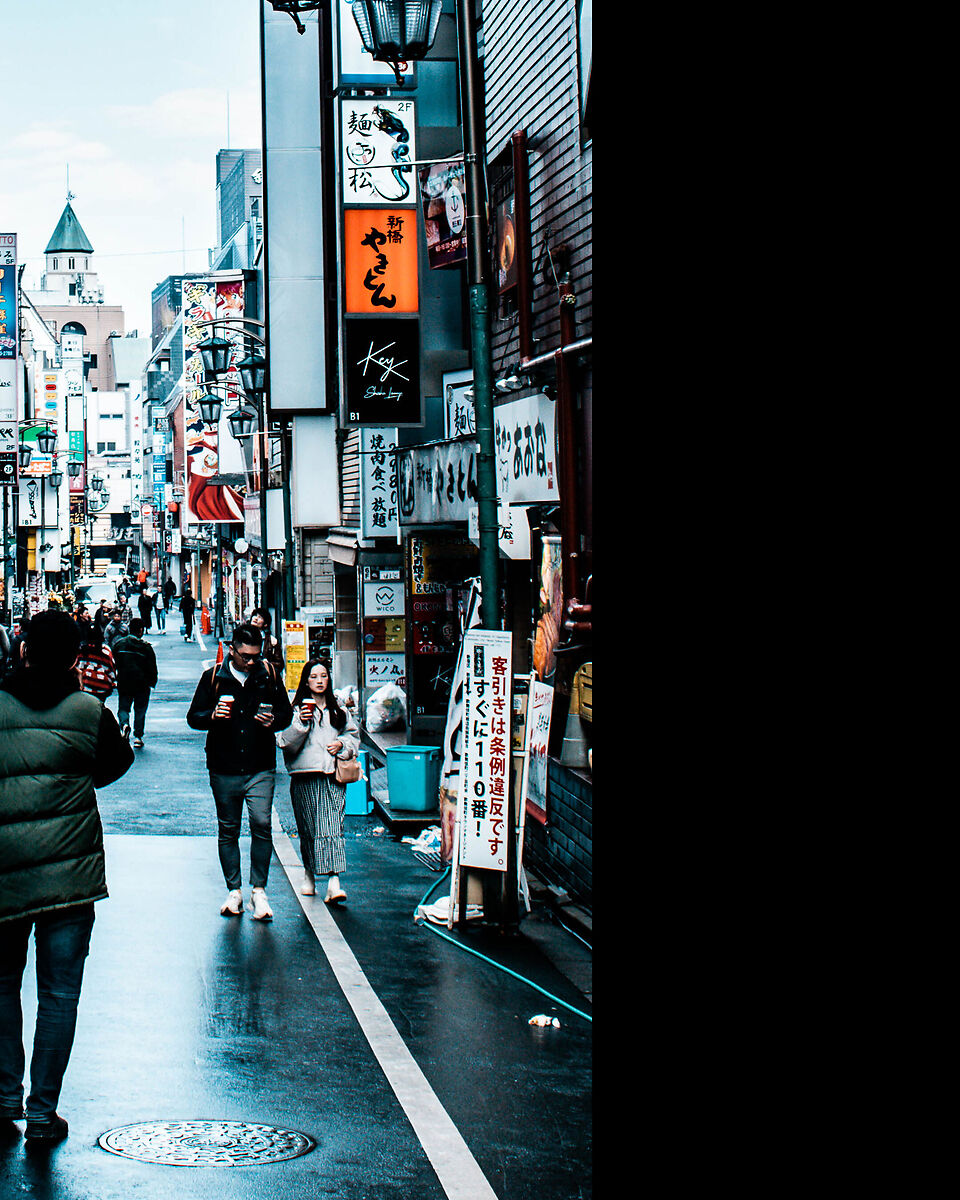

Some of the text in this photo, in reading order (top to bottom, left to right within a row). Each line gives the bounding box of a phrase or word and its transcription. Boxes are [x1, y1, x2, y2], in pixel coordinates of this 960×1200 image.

[397, 103, 413, 112] 2F
[386, 215, 404, 244] 新橋
[361, 227, 396, 308] やきとん
[357, 341, 410, 382] Key
[350, 412, 360, 421] B1
[370, 434, 387, 528] 焼肉食べ放題
[487, 655, 508, 865] 客引きは条例違反です。
